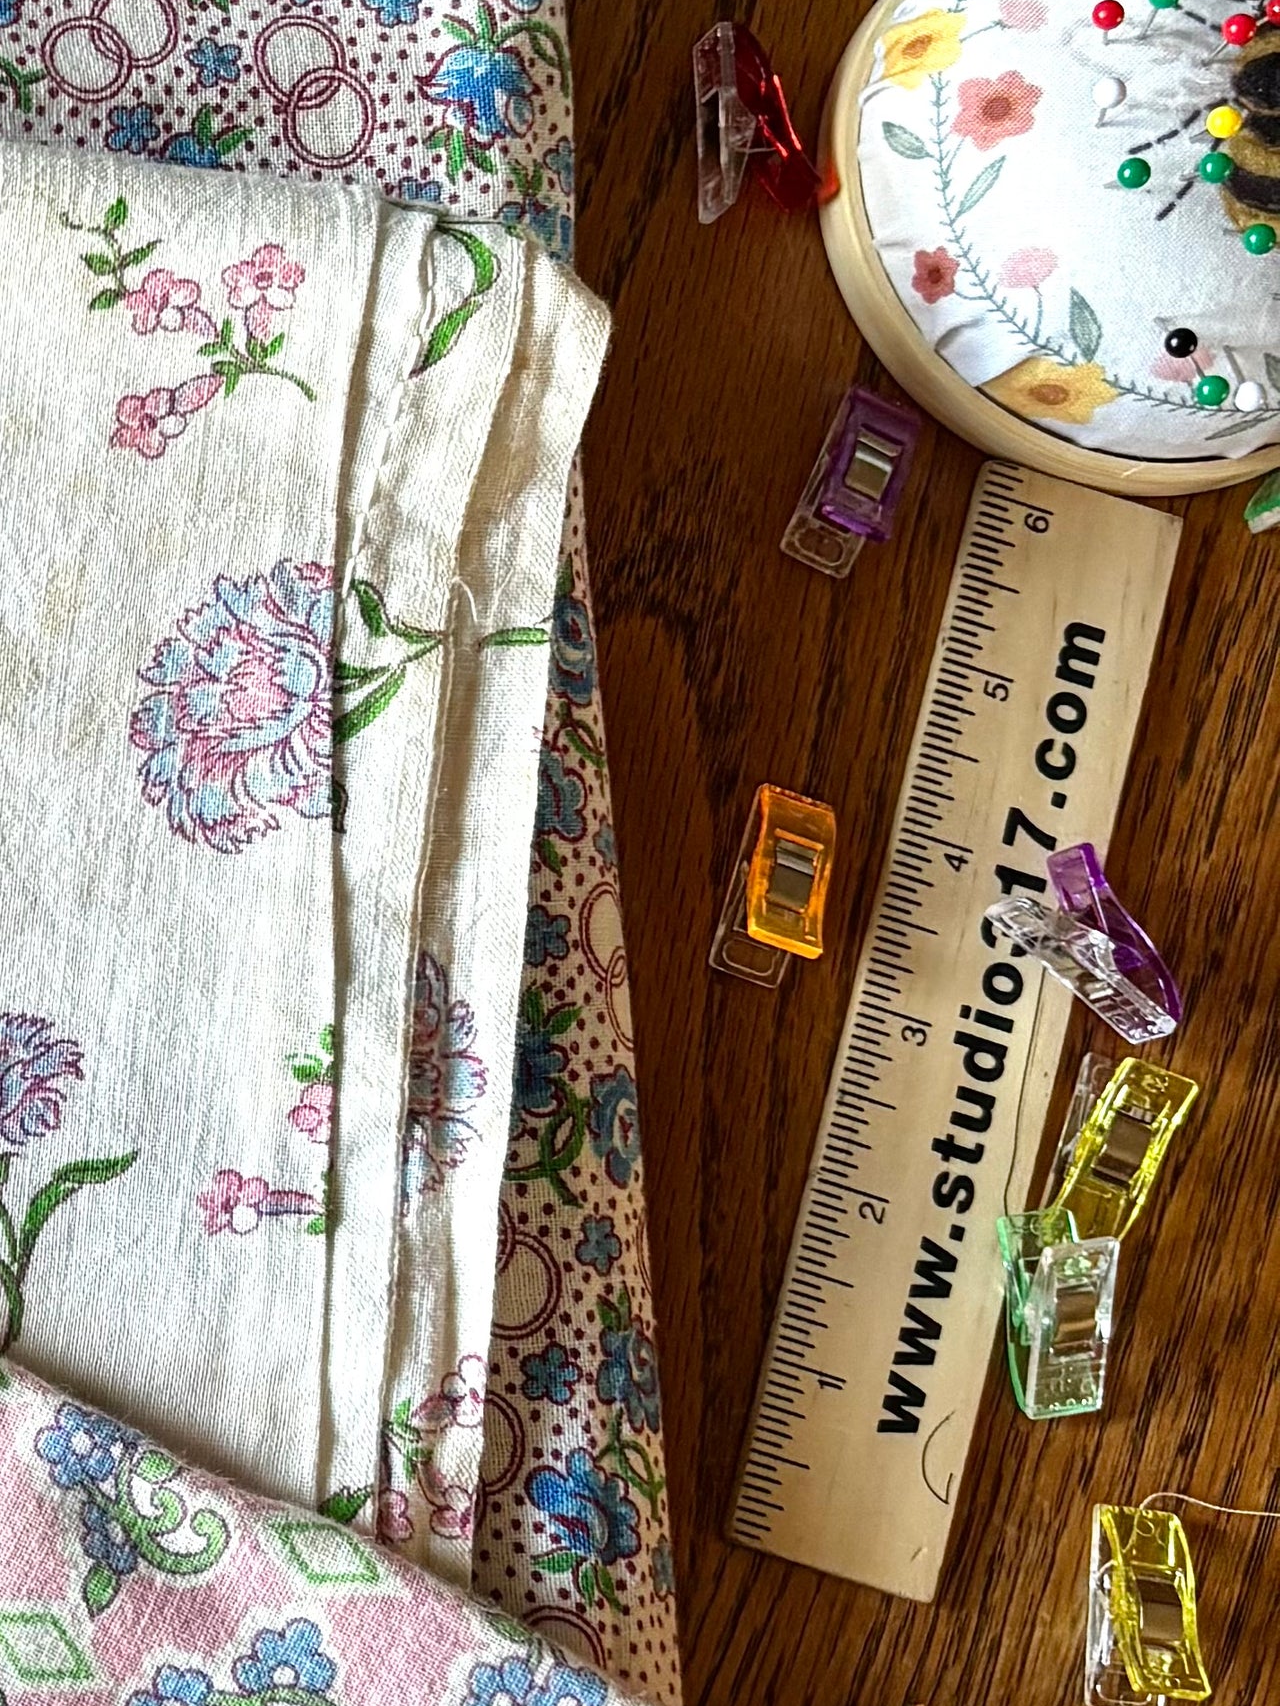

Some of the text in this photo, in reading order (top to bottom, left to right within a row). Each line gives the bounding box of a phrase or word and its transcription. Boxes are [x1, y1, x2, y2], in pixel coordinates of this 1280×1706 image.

[983, 680, 1009, 702] 5
[944, 853, 968, 872] 4
[901, 1024, 928, 1047] 3
[858, 1200, 886, 1225] 2
[817, 1374, 844, 1391] 1
